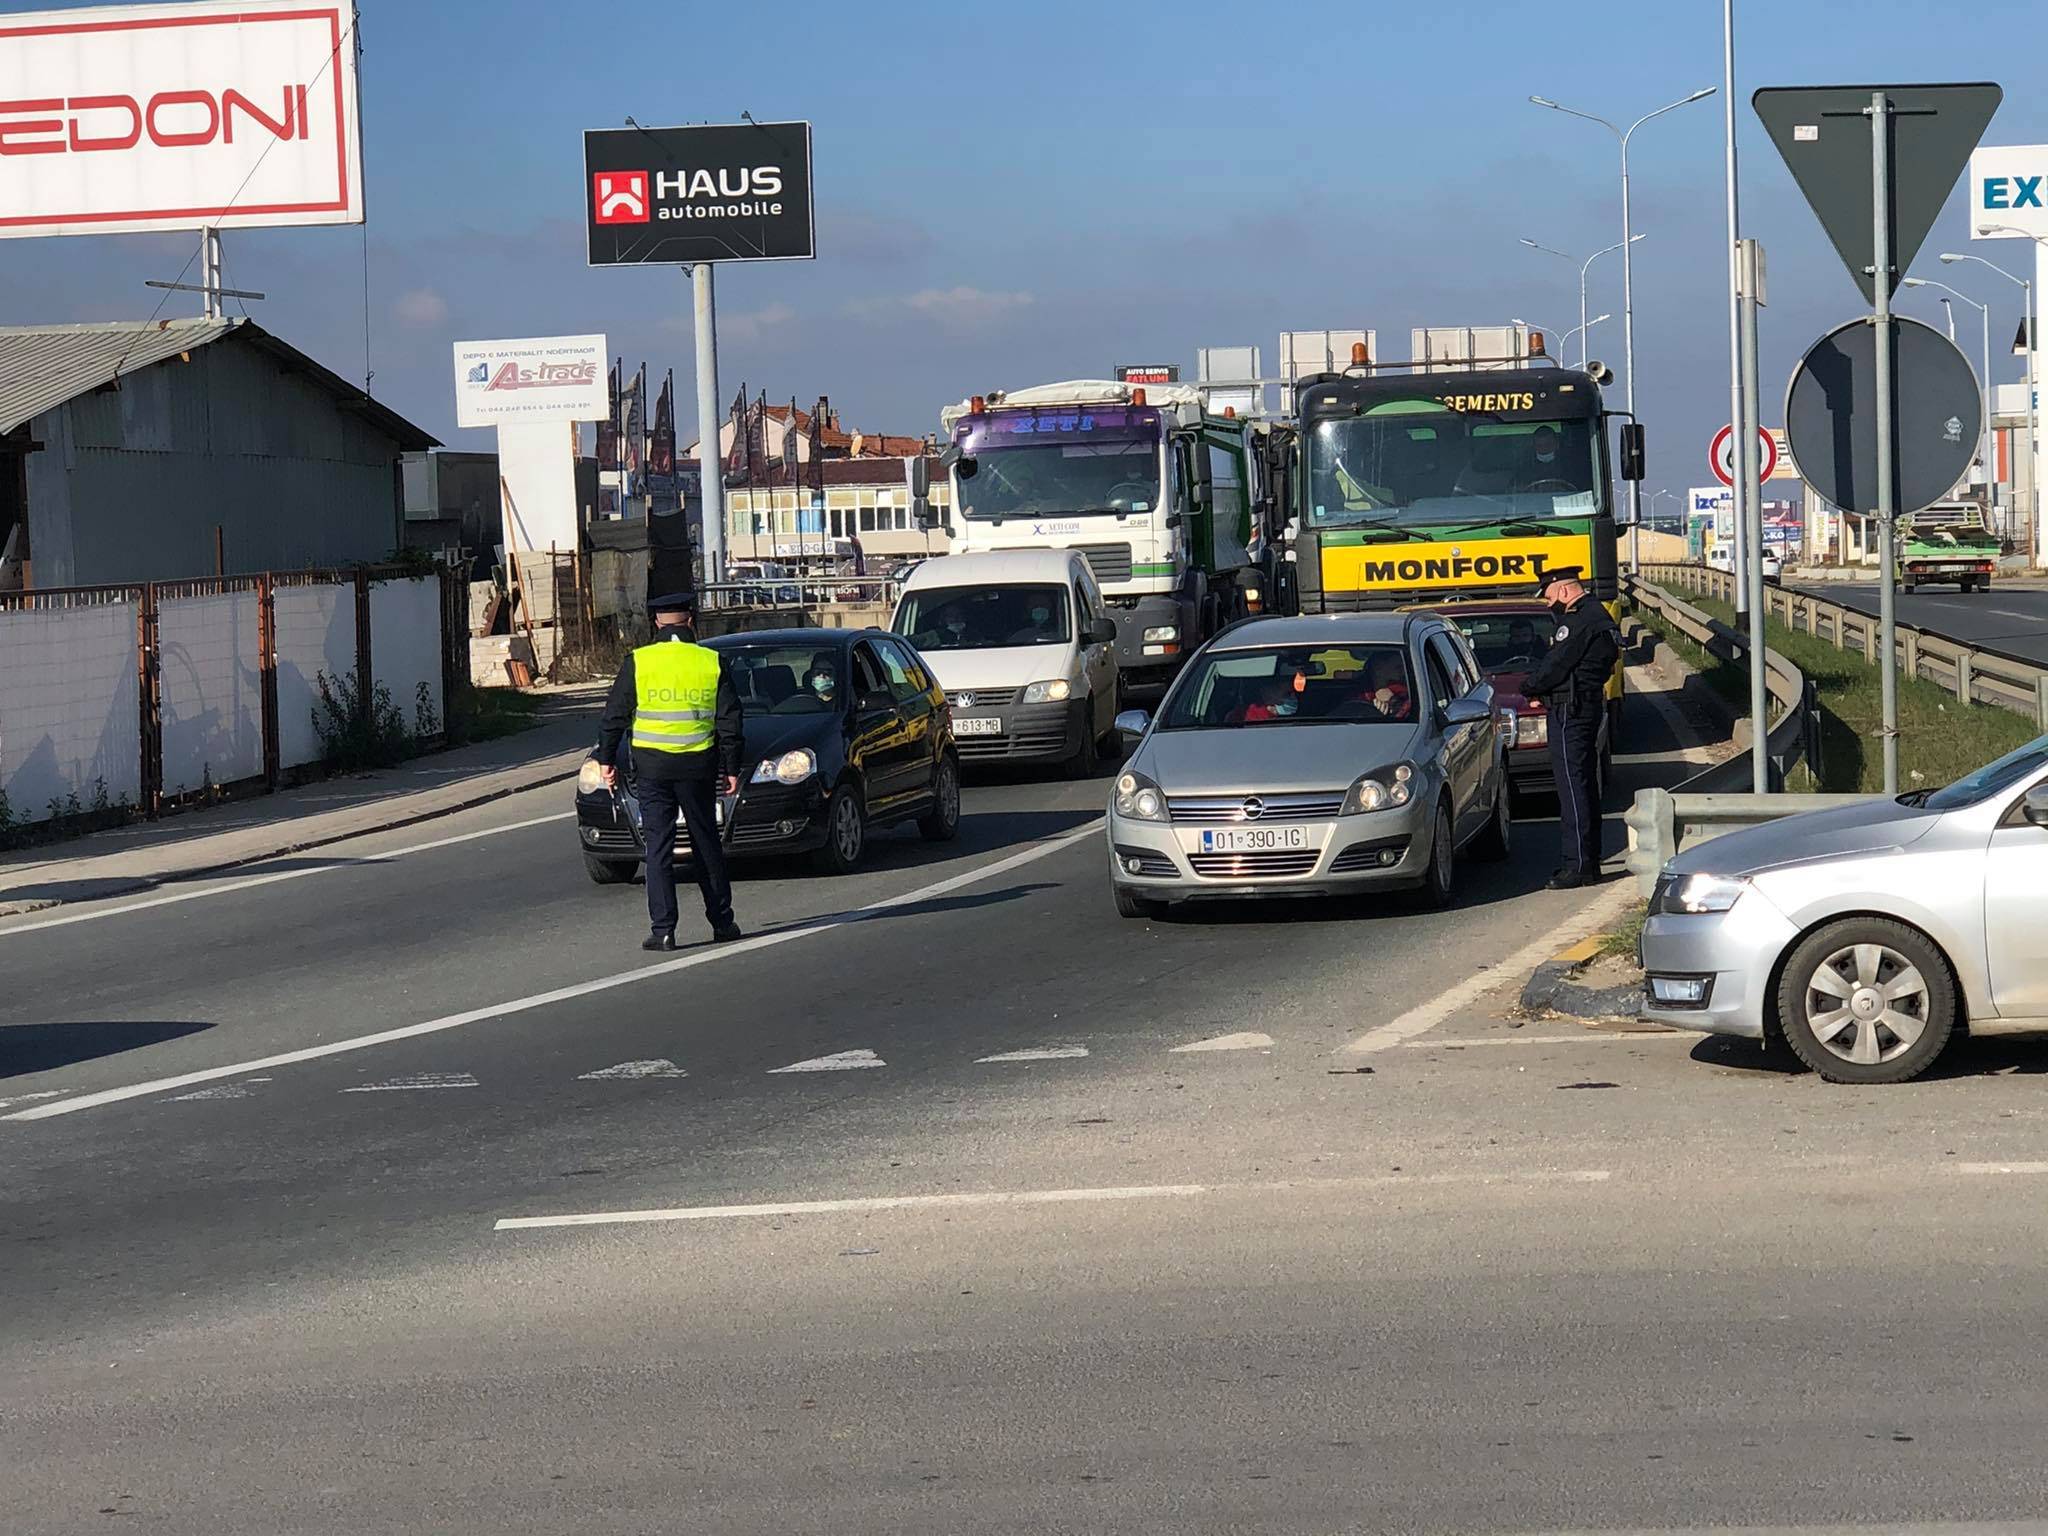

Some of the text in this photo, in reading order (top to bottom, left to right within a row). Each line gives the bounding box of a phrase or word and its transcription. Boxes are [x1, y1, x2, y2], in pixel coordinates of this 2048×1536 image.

[656, 166, 783, 199] HAUS
[1984, 175, 2048, 210] EX
[658, 201, 783, 219] automobile
[463, 352, 486, 360] DEPO
[1011, 415, 1095, 433] XETI
[1365, 554, 1549, 582] MONFORT
[647, 688, 713, 703] POLICE
